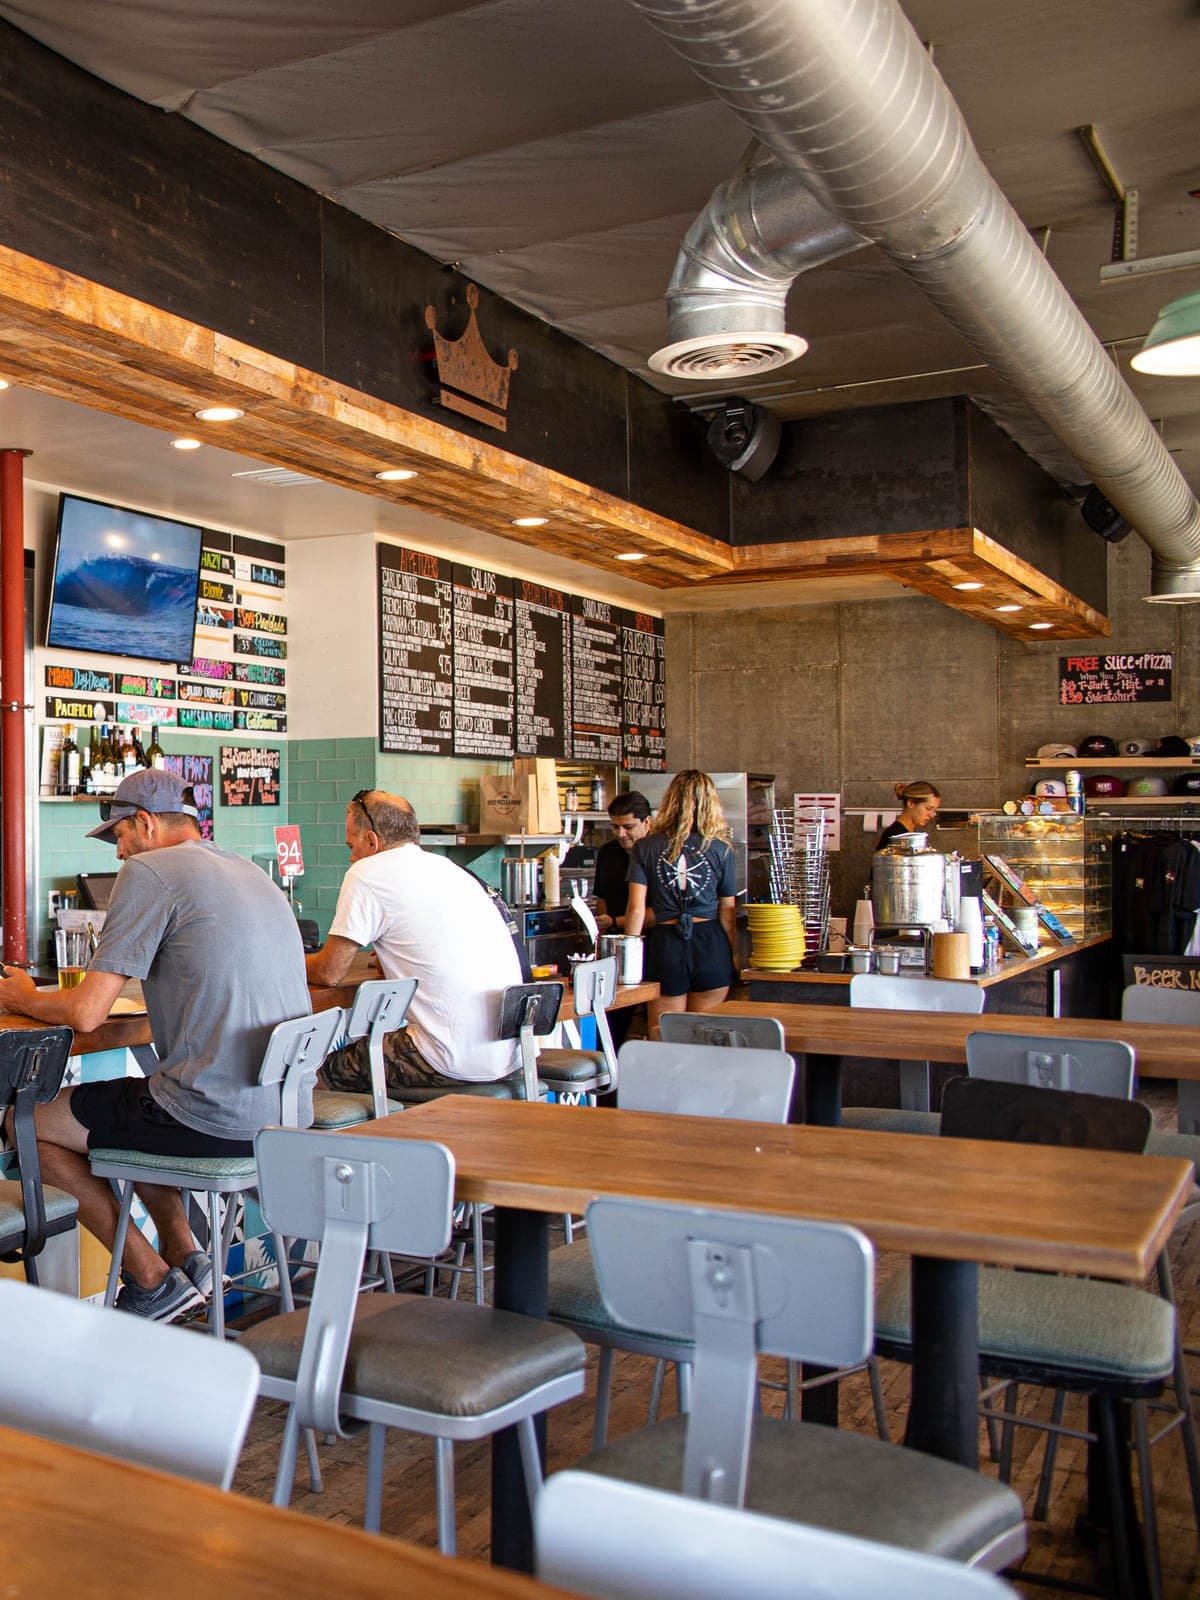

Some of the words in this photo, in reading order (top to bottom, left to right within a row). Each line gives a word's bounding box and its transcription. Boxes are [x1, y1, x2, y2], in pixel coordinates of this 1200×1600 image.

[201, 553, 220, 570] HAZY
[401, 548, 439, 579] APPETIZERS
[471, 567, 497, 594] SALADS
[382, 596, 402, 616] FRENCH
[403, 599, 417, 619] FRIES
[454, 593, 473, 612] CAESAR
[468, 625, 484, 645] HOUSE
[1067, 657, 1099, 671] FREE
[249, 692, 276, 707] GUINNESS
[1085, 691, 1137, 703] Sweatshirt
[55, 699, 93, 718] PACIFICO
[398, 708, 417, 728] CHEESE
[278, 840, 301, 864] 94
